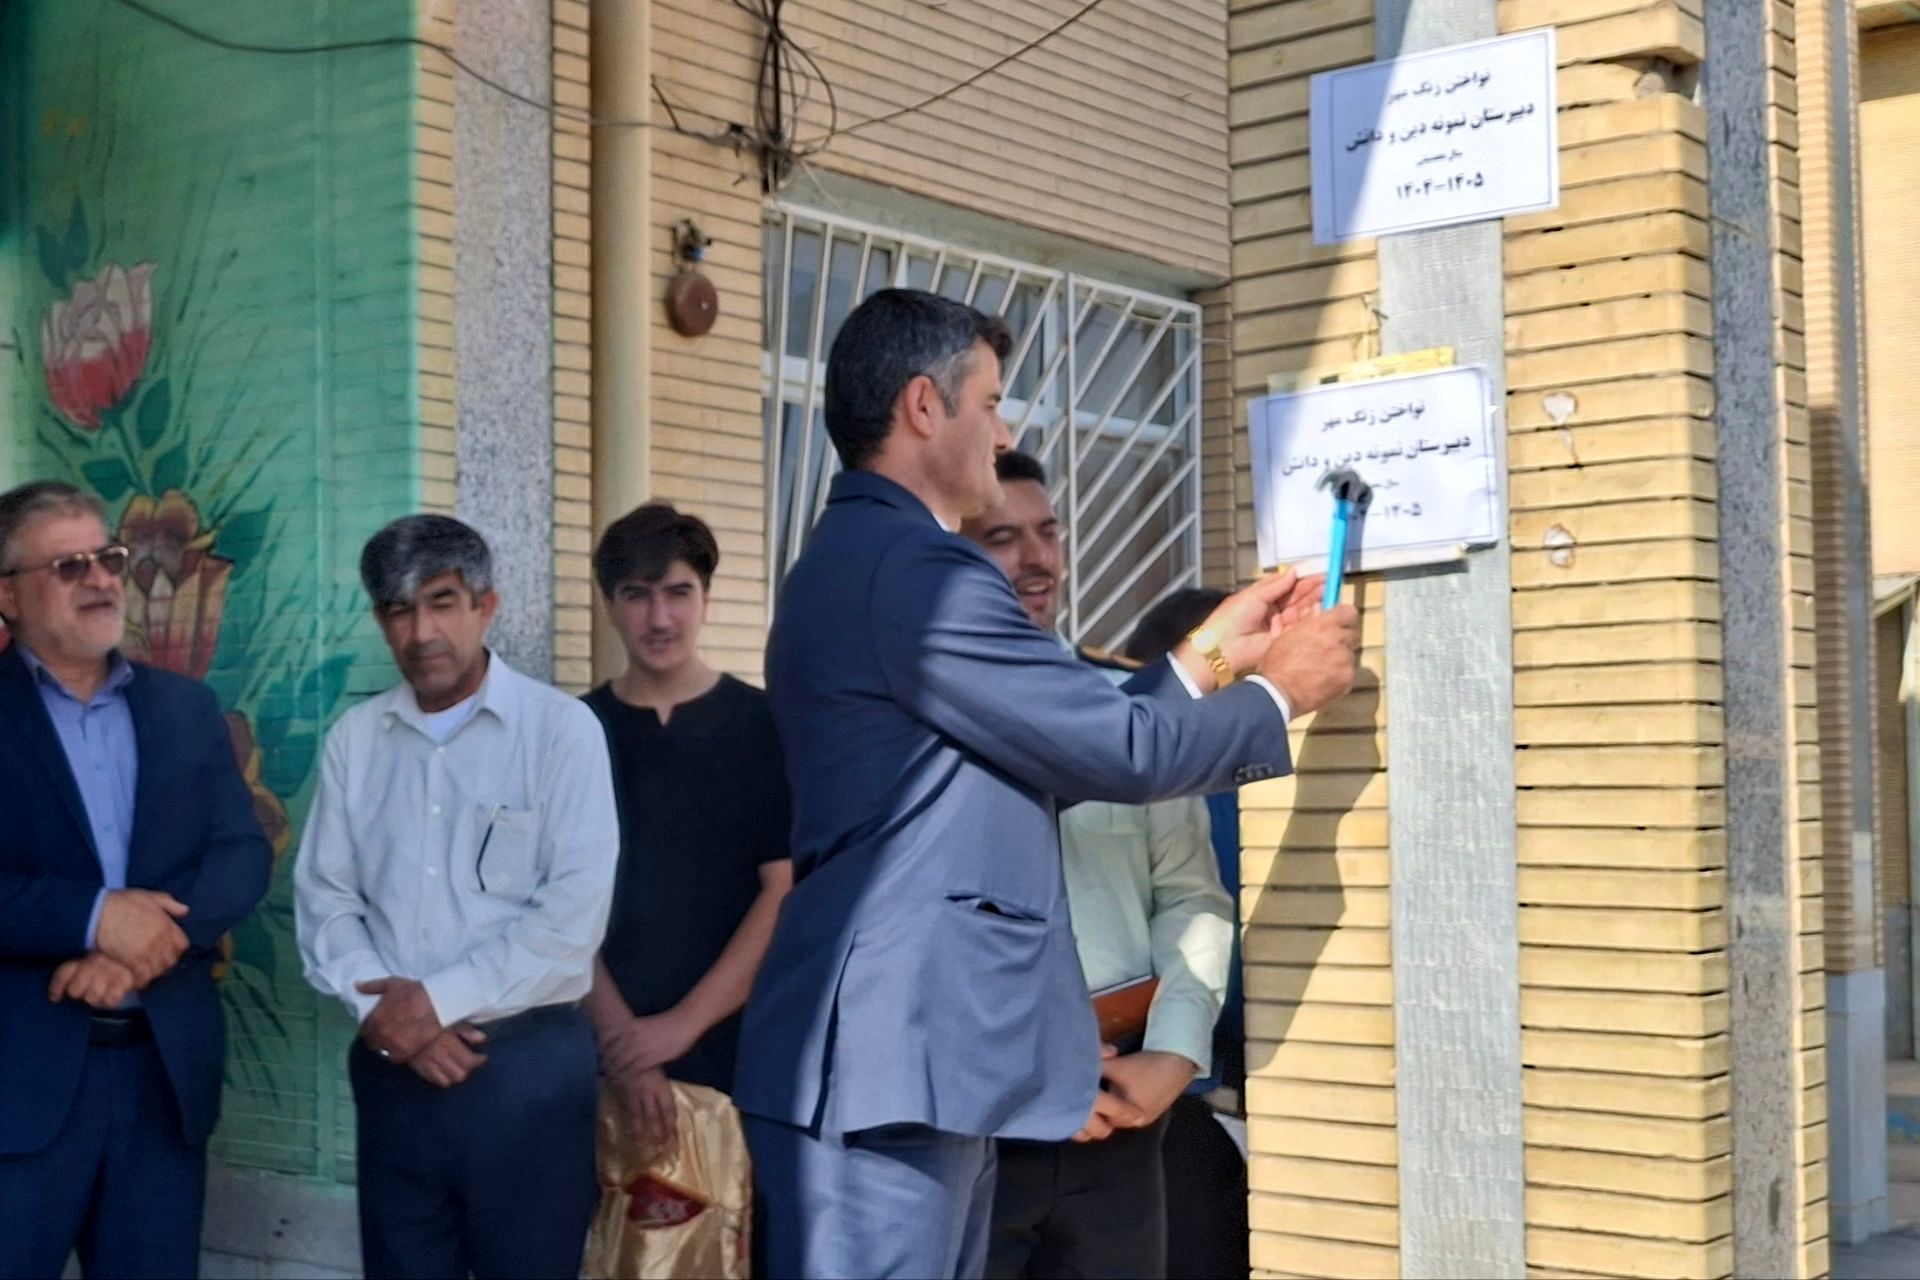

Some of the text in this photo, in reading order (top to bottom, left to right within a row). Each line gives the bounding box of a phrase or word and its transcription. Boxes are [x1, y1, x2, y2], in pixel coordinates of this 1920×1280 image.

[1431, 113, 1467, 135] نمونه
[1469, 102, 1535, 130] دبیرستان
[1345, 128, 1383, 152] دانش
[1388, 132, 1396, 144] و
[1366, 444, 1403, 465] نمونه
[1405, 436, 1472, 459] دبیرستان
[1282, 454, 1319, 477] دانش
